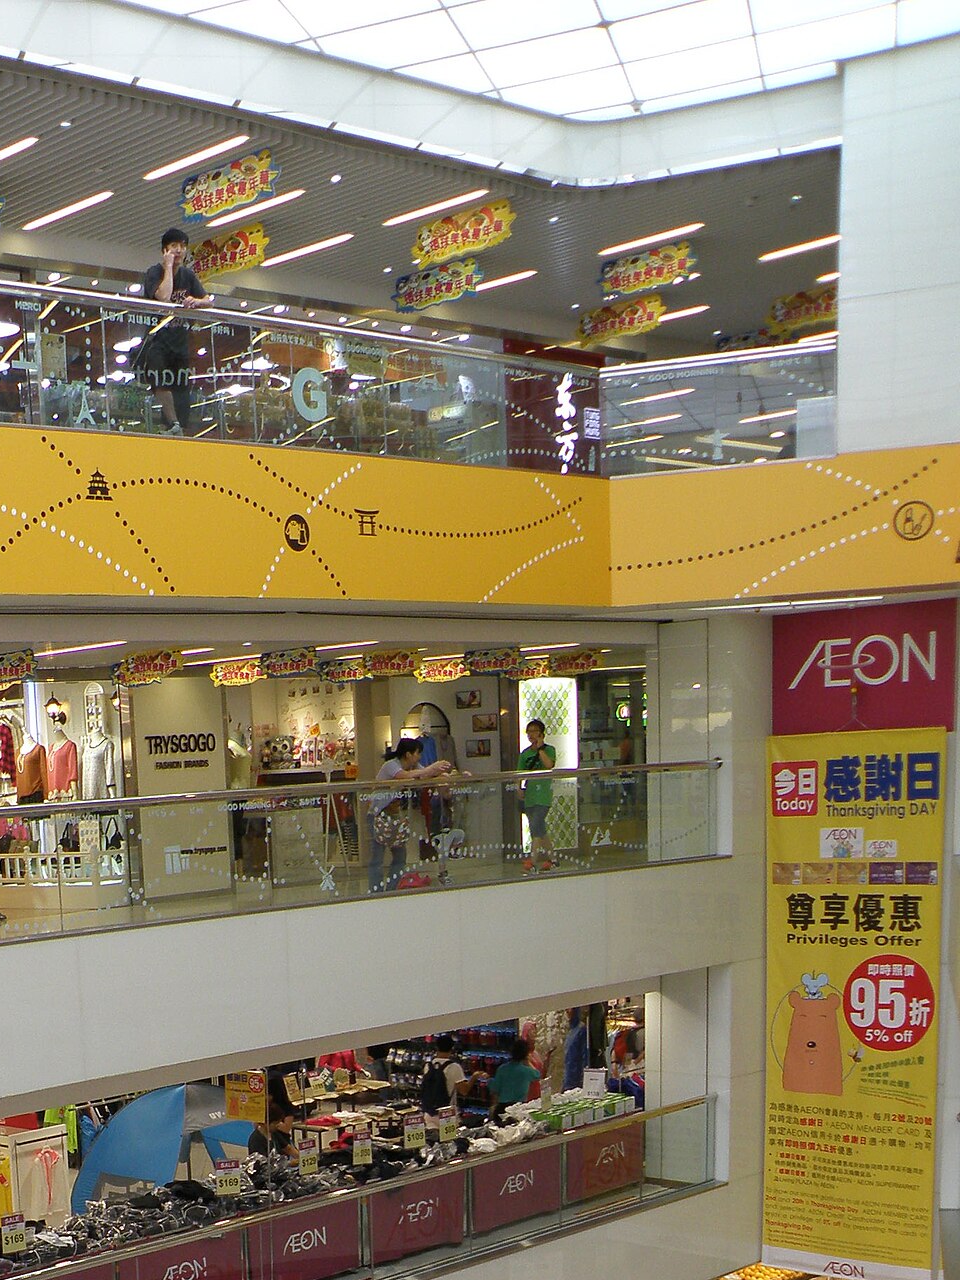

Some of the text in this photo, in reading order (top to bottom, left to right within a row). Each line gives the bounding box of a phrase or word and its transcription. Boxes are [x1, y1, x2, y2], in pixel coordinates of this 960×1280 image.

[145, 732, 215, 756] TRYSGOGO
[774, 767, 816, 797] 今日
[824, 752, 940, 803] 感謝日
[776, 798, 814, 812] Today
[826, 802, 937, 819] Thanksgiving DAY
[786, 892, 922, 933] 尊享優惠
[787, 933, 922, 948] Privileges Offer
[865, 1029, 913, 1042] 5% off
[218, 1177, 238, 1188] $169
[4, 1233, 25, 1246] $169
